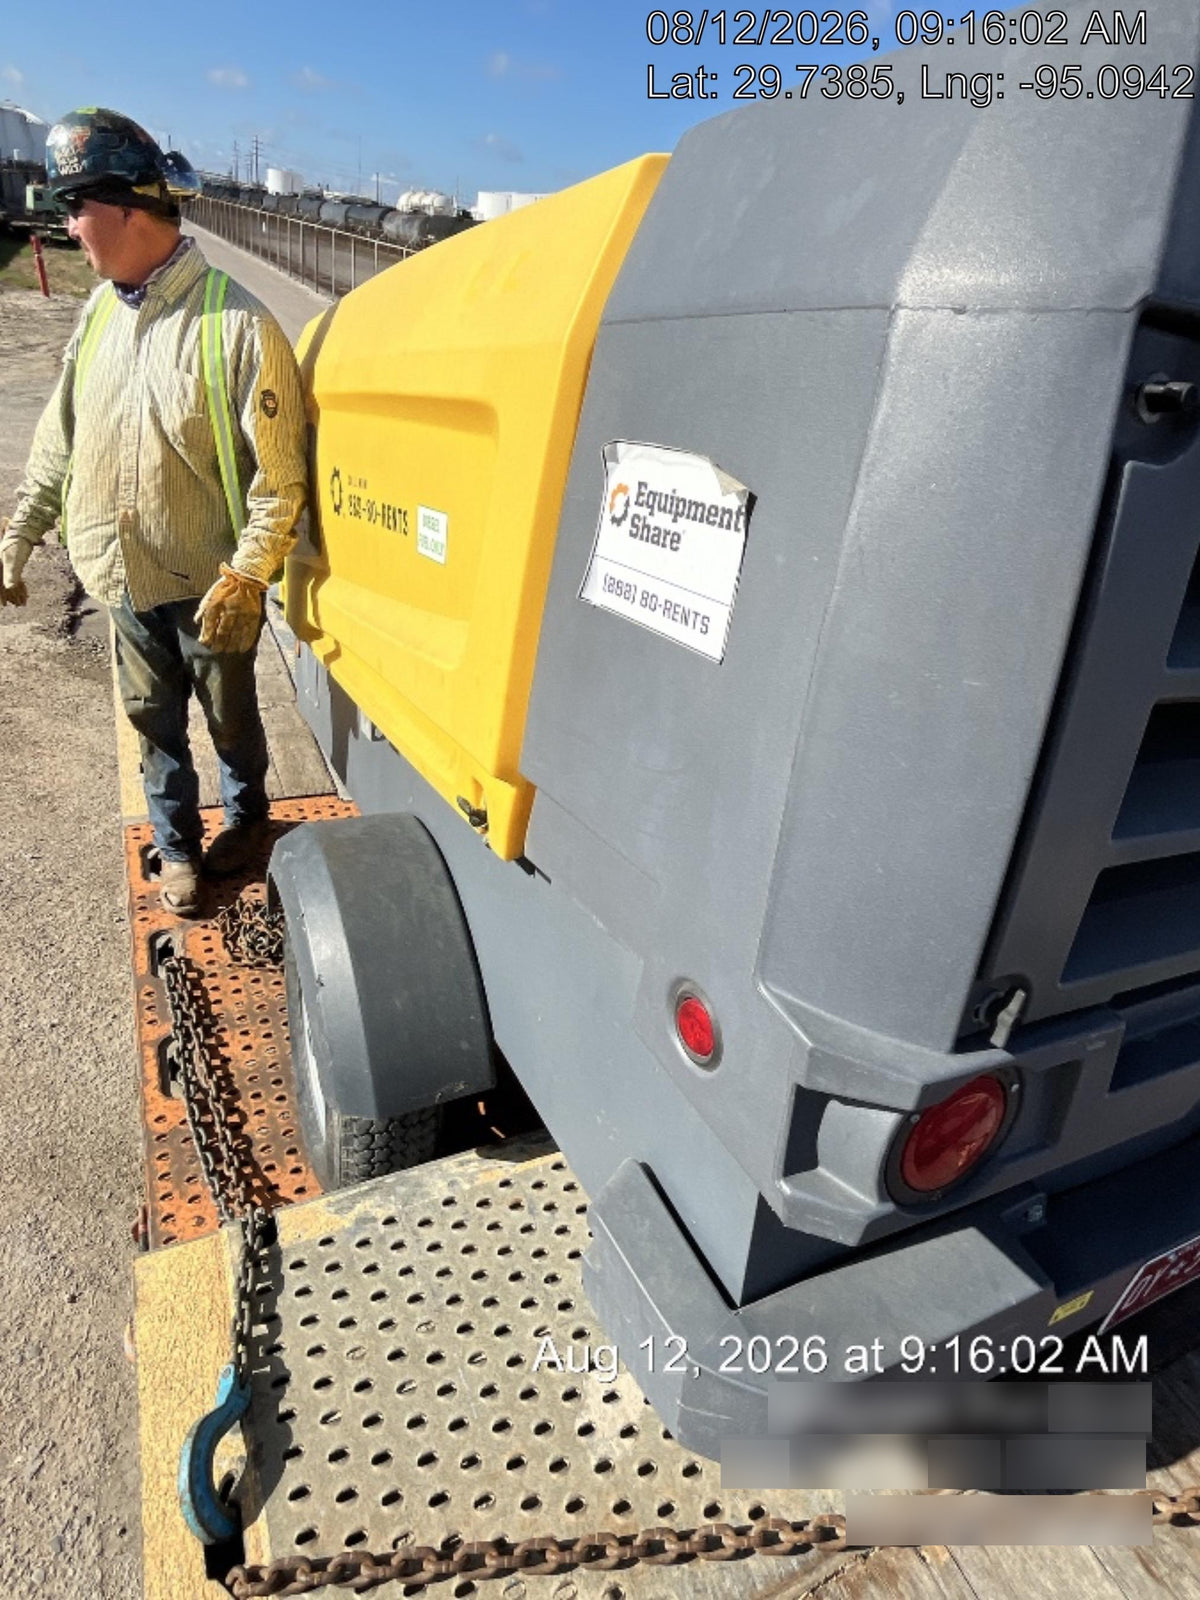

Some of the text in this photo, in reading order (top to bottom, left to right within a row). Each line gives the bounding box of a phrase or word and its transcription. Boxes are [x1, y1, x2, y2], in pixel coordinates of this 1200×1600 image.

[629, 513, 682, 552] Share
[634, 480, 746, 533] Equipment
[602, 572, 711, 636] (888) 80-RENTS
